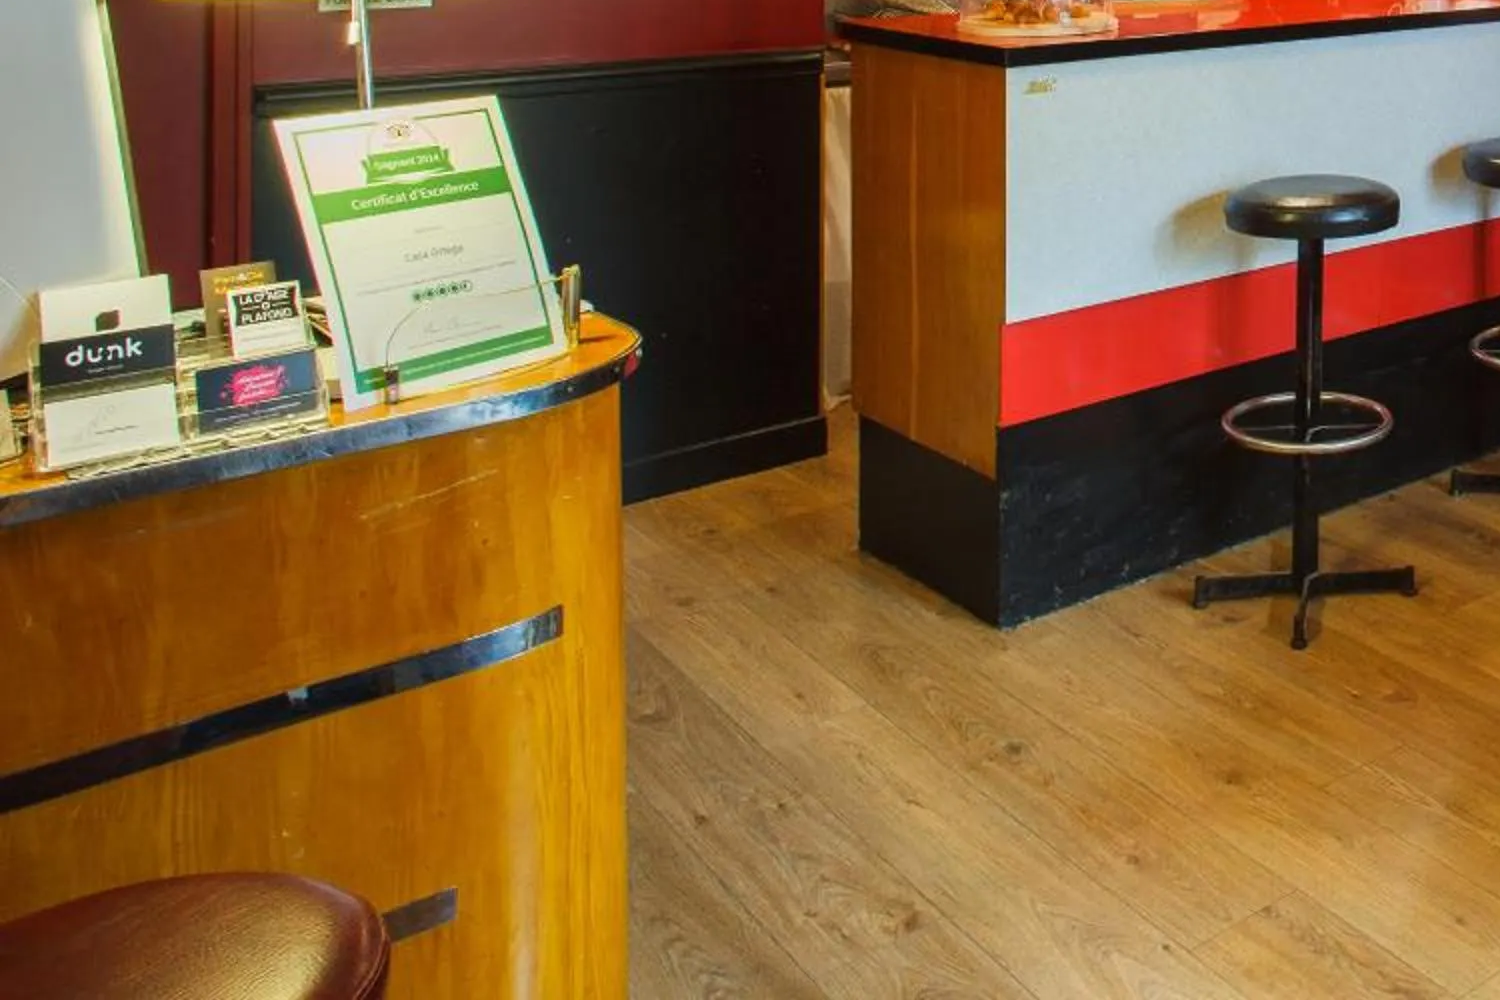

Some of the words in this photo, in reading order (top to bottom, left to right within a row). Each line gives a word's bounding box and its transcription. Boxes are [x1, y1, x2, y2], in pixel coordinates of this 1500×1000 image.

[351, 190, 407, 210] Certificat
[409, 181, 479, 201] d'Excellence
[64, 337, 144, 367] dunk
